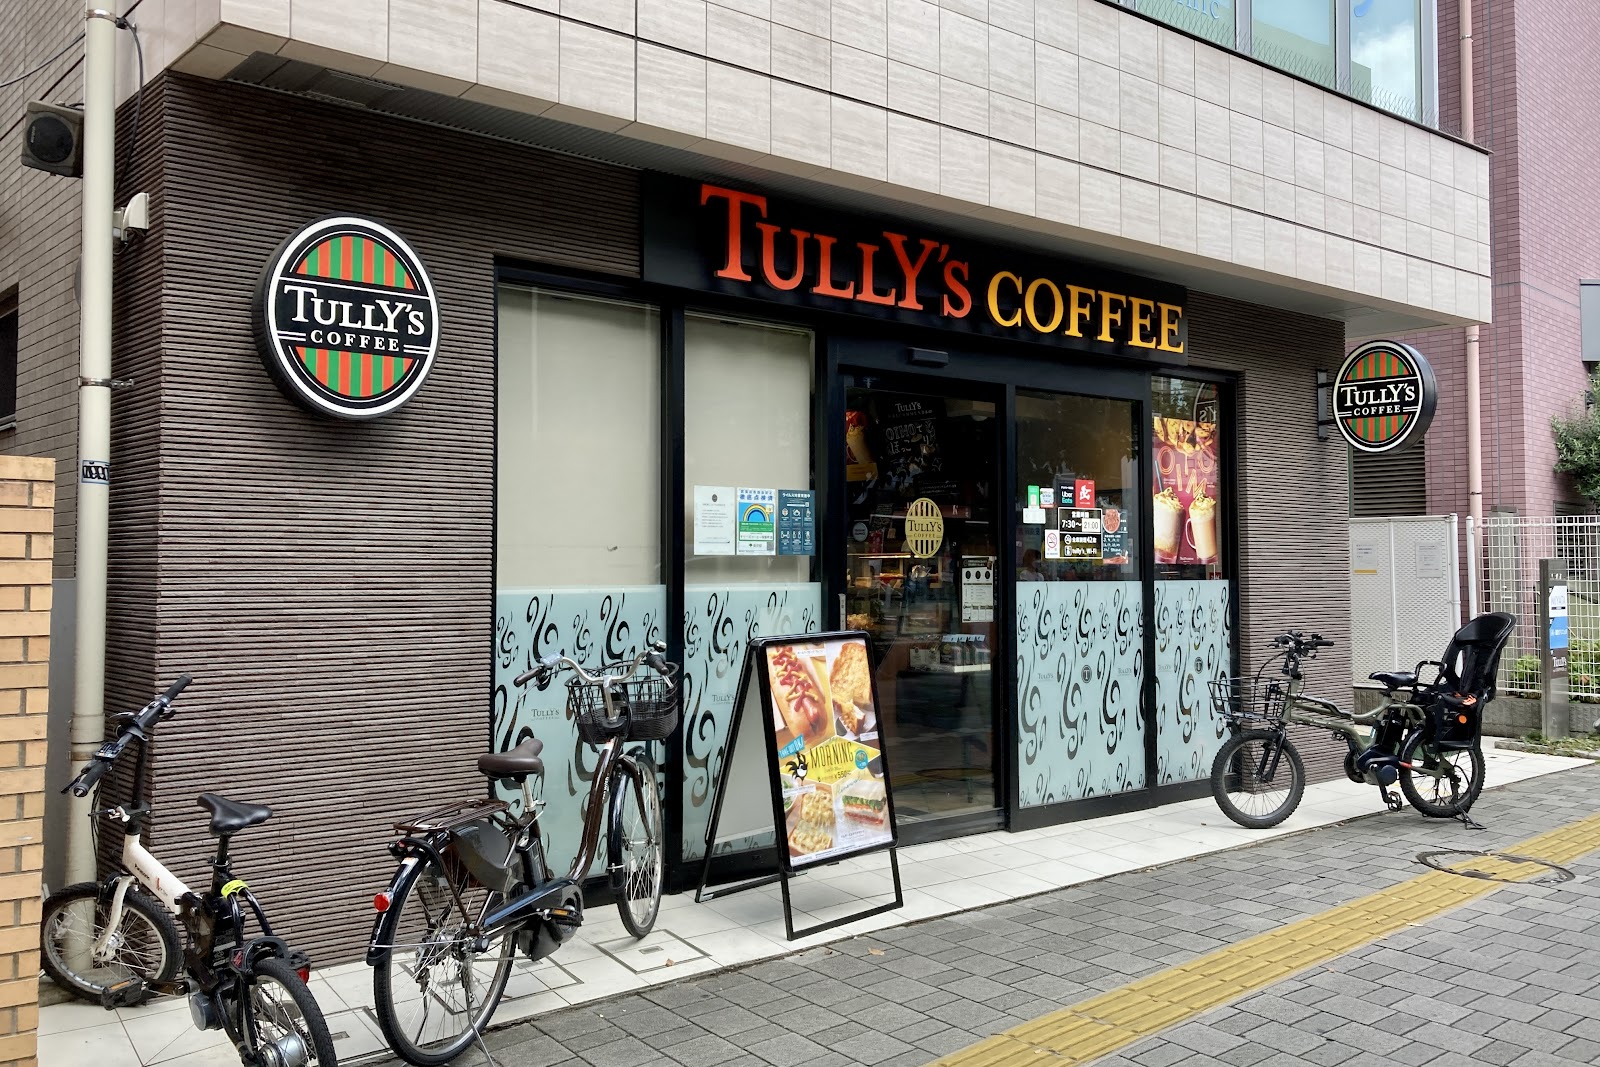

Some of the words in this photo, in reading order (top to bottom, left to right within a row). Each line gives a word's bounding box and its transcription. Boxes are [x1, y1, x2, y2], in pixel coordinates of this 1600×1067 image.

[701, 183, 972, 318] TULLY'S
[987, 270, 1184, 353] COFFEE
[284, 284, 425, 336] TULLY'S
[310, 329, 400, 352] COFFEE
[1340, 383, 1416, 406] TULLY'S
[895, 401, 922, 412] TULLY'S
[1353, 404, 1401, 416] COFFEE
[908, 519, 942, 533] TULLY'S
[530, 708, 560, 717] TULLY'S
[810, 741, 854, 769] MORNING
